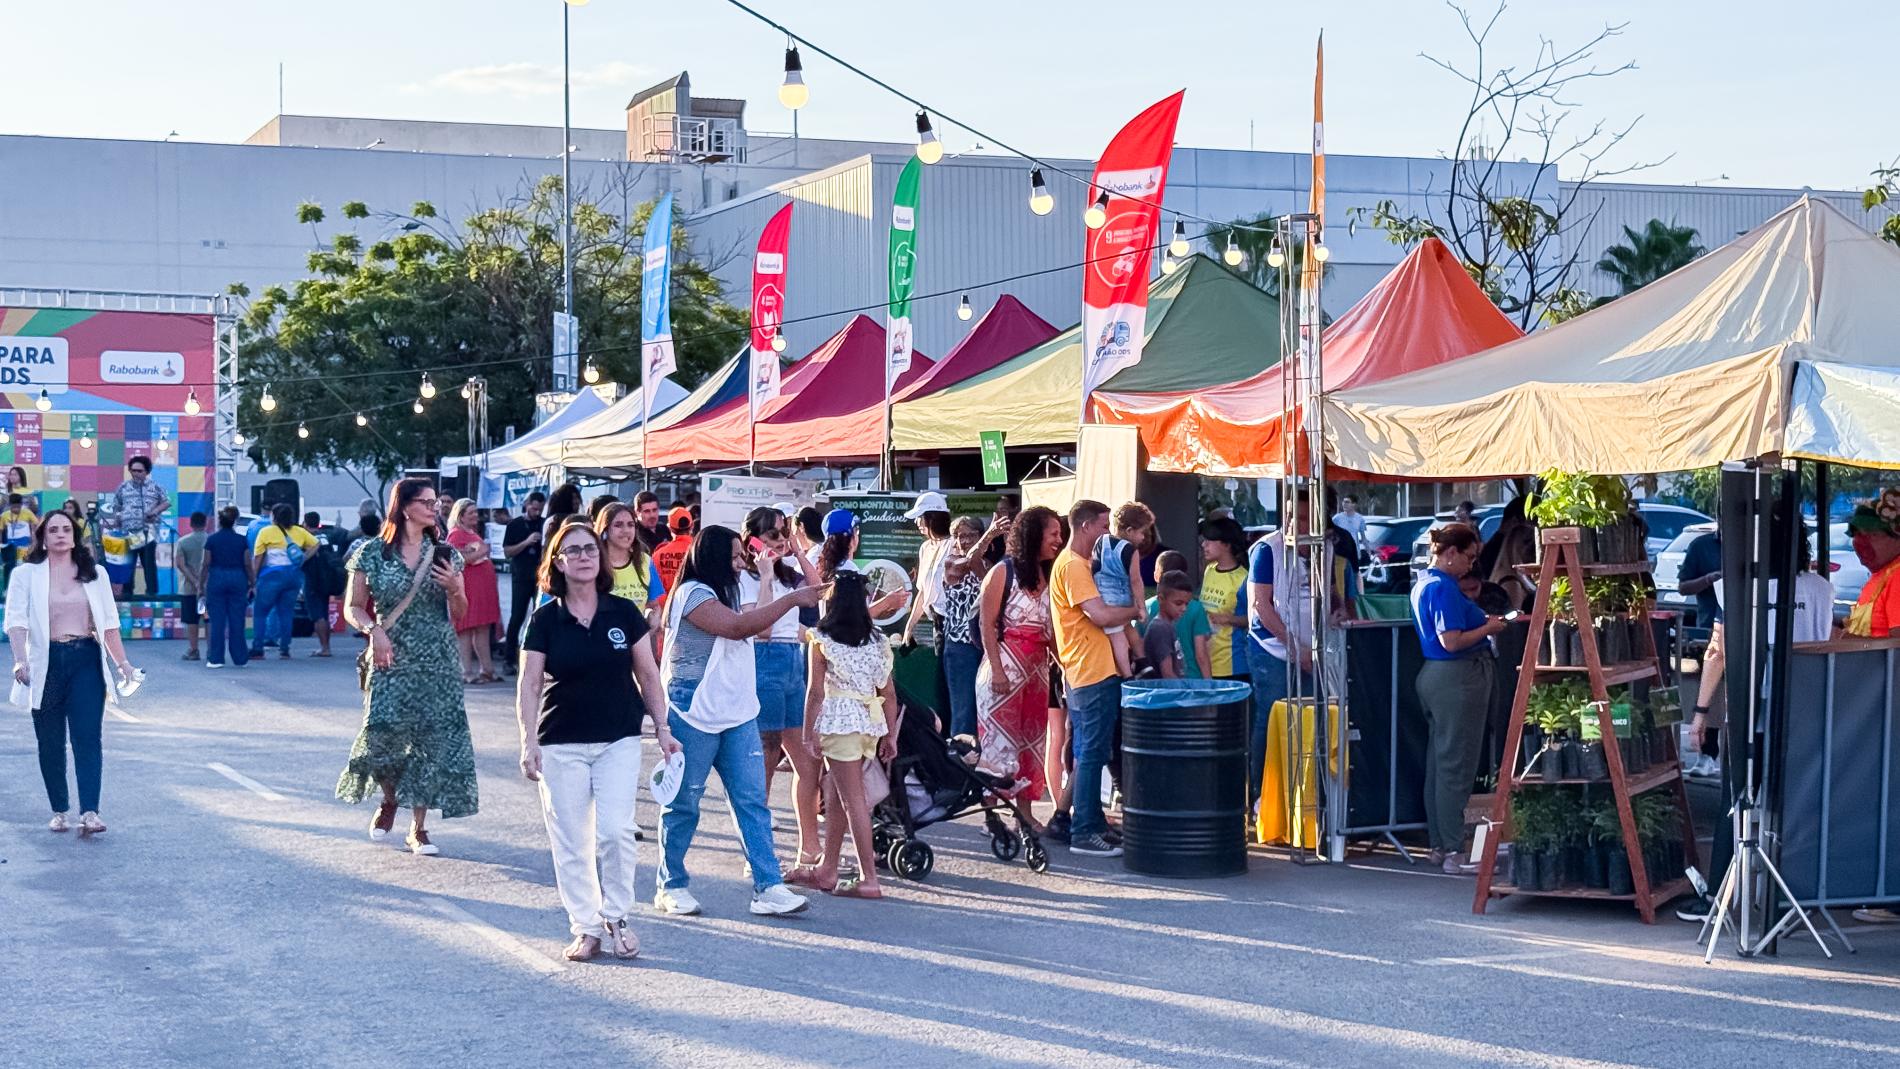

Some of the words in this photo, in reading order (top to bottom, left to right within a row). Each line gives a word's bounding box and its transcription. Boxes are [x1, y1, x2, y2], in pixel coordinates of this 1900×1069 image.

[1105, 230, 1113, 244] 9
[0, 346, 54, 364] PARA
[109, 364, 160, 375] Rabobank
[833, 501, 858, 509] COMO
[860, 501, 894, 509] MONTAR
[895, 502, 908, 510] UM
